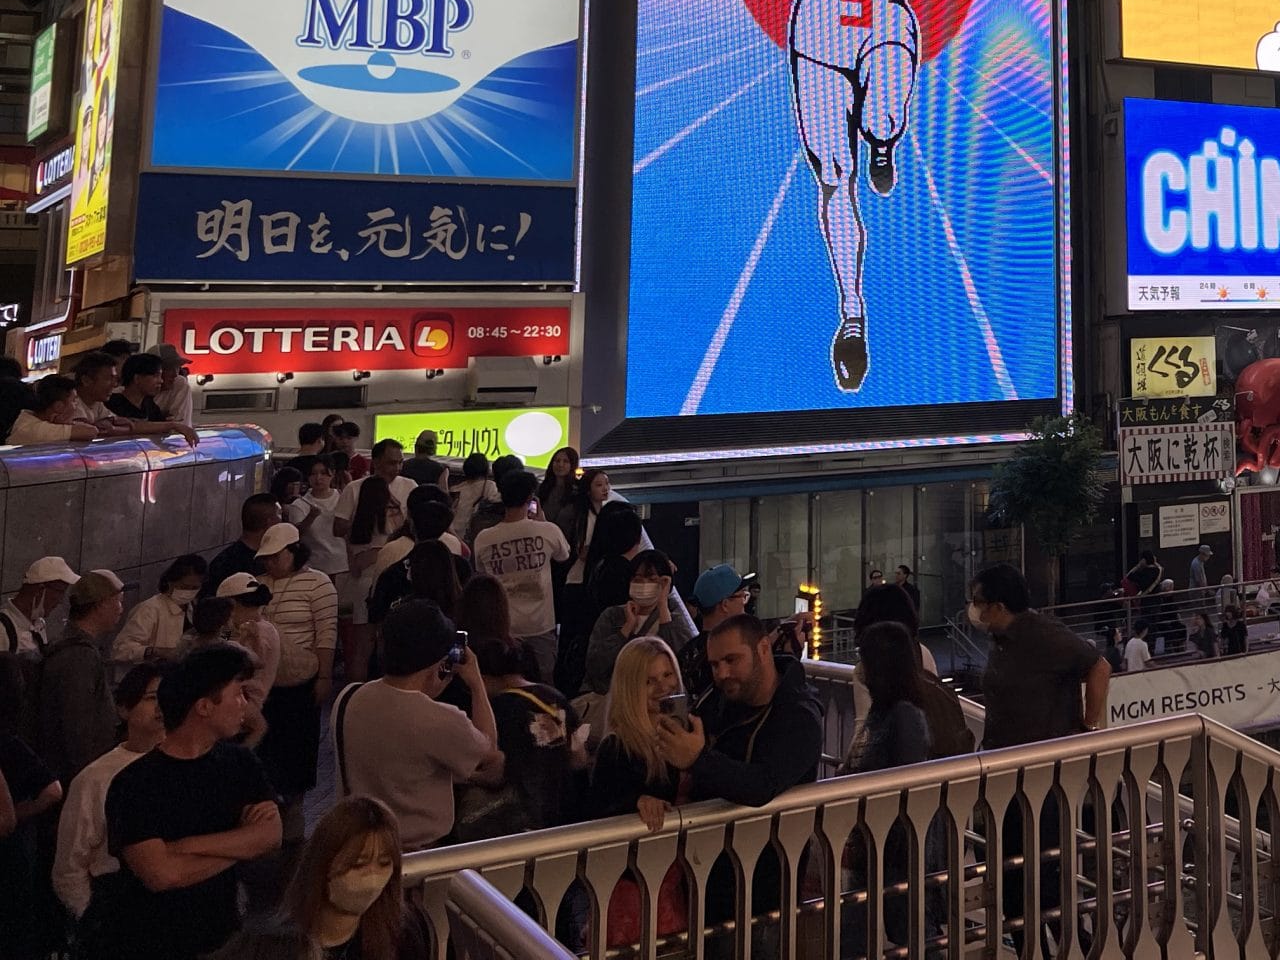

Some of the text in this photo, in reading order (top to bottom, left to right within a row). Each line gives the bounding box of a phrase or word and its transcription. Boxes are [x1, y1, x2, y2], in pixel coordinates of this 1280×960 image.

[1138, 286, 1180, 302] 天気予報
[184, 326, 405, 355] LOTTERIA
[1127, 433, 1219, 473] 大阪に乾杯
[491, 535, 544, 560] ASTRO
[1111, 698, 1155, 722] MGM
[1162, 683, 1246, 714] RESORTS
